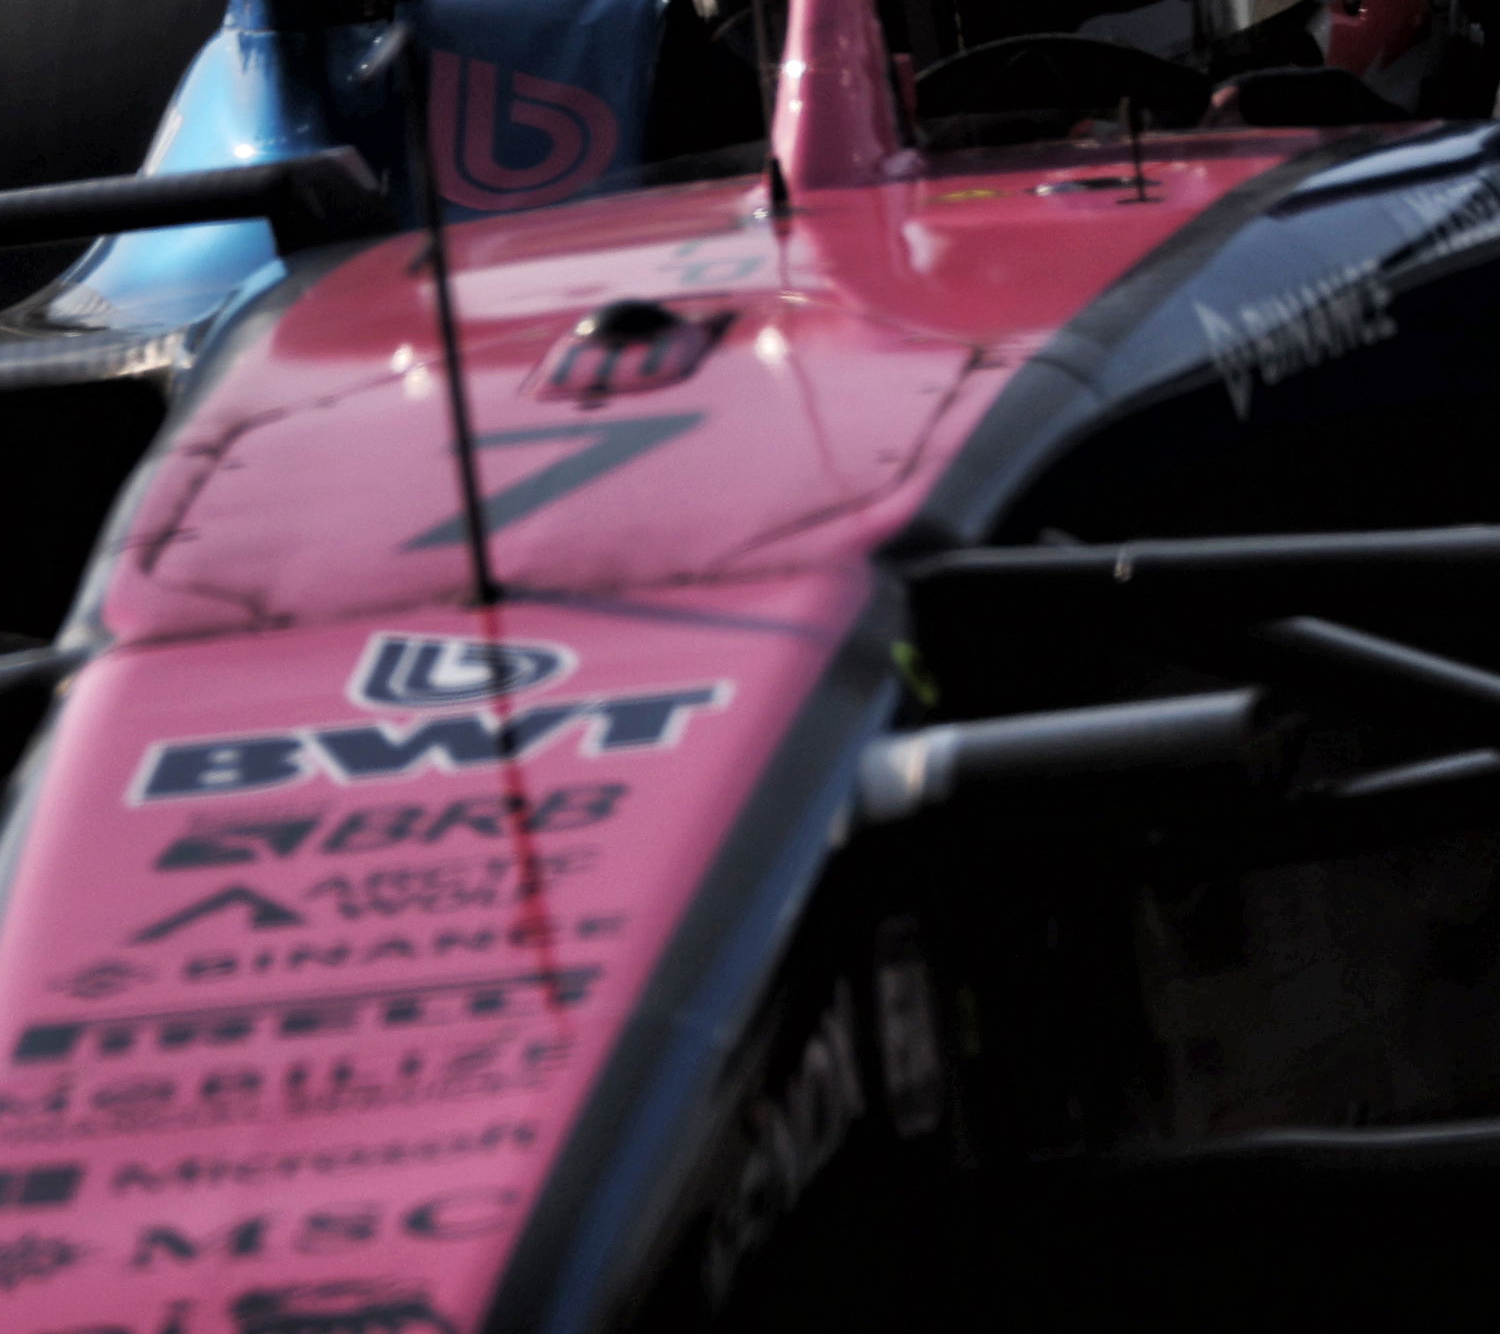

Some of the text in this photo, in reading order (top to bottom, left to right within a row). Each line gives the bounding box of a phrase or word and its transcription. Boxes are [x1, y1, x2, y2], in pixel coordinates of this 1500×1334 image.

[400, 412, 706, 553] 7
[128, 681, 733, 806] BWT
[112, 1122, 538, 1194] Microsoft
[130, 1187, 521, 1271] MSC
